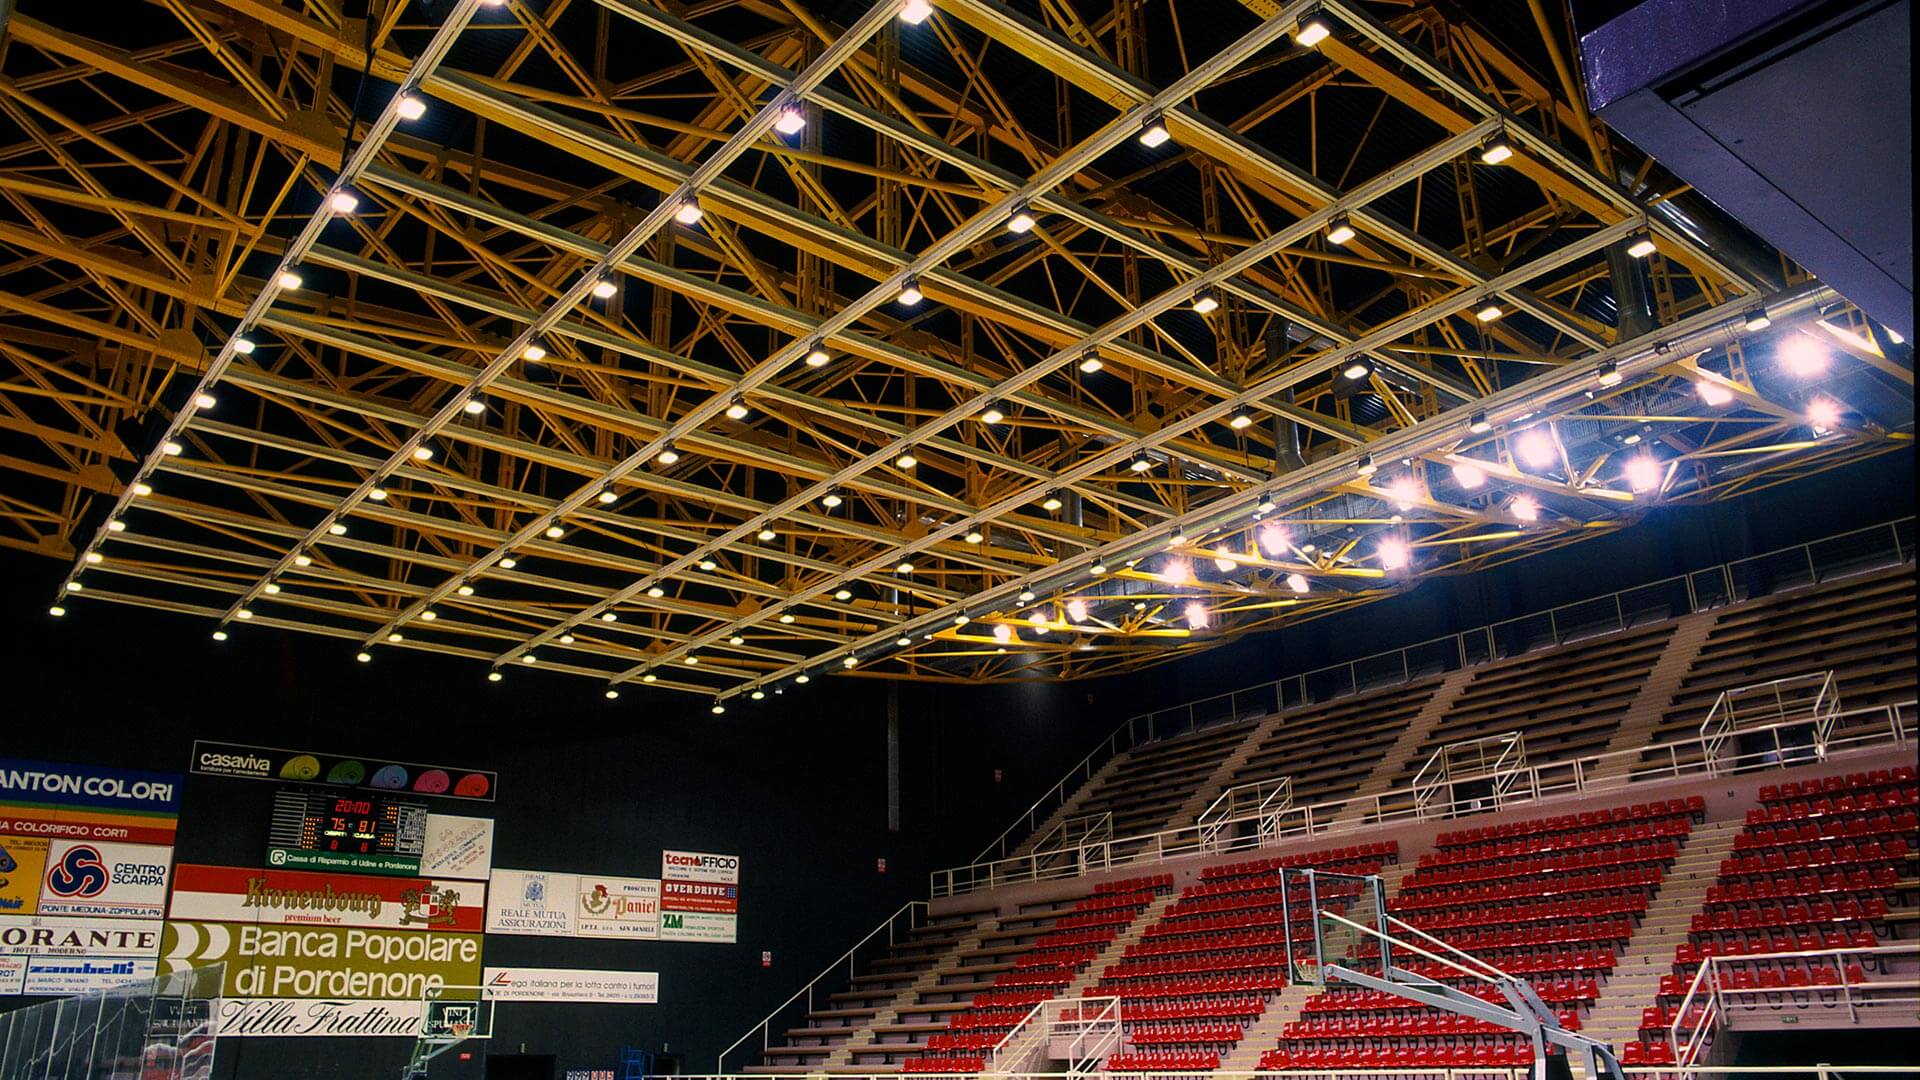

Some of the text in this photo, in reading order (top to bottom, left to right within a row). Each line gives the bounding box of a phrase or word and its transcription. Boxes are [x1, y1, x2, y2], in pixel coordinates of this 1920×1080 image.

[200, 753, 270, 771] casaviva
[83, 777, 174, 802] COLORI
[14, 821, 90, 837] COLORIFICIO
[93, 827, 129, 838] CORTI
[331, 817, 376, 833] 75 81
[286, 854, 308, 863] Cassa
[309, 855, 316, 863] di
[318, 857, 350, 867] Risparmio
[351, 857, 357, 866] di
[359, 858, 377, 867] Udine
[114, 862, 166, 876] CENTRO
[112, 874, 164, 887] SCARPA
[623, 885, 657, 893] PROSCIUTTI
[665, 883, 725, 896] OVERDRIVE
[242, 877, 382, 920] Kronenbourg
[41, 904, 70, 913] PONTE
[501, 908, 567, 920] REALE MUTUA
[284, 913, 342, 923] premium beer
[498, 918, 567, 929] ASSICURAZIONI
[12, 946, 41, 954] HOTEL
[238, 926, 478, 965] Banca Popolare
[30, 961, 135, 975] zambelli
[235, 965, 445, 999] di Pordenone
[530, 979, 558, 988] italiana
[560, 980, 573, 989] per
[576, 980, 583, 988] la
[585, 980, 601, 989] lotta
[603, 981, 628, 990] contro
[633, 981, 656, 990] tumori
[219, 1000, 421, 1034] Villa Frattina
